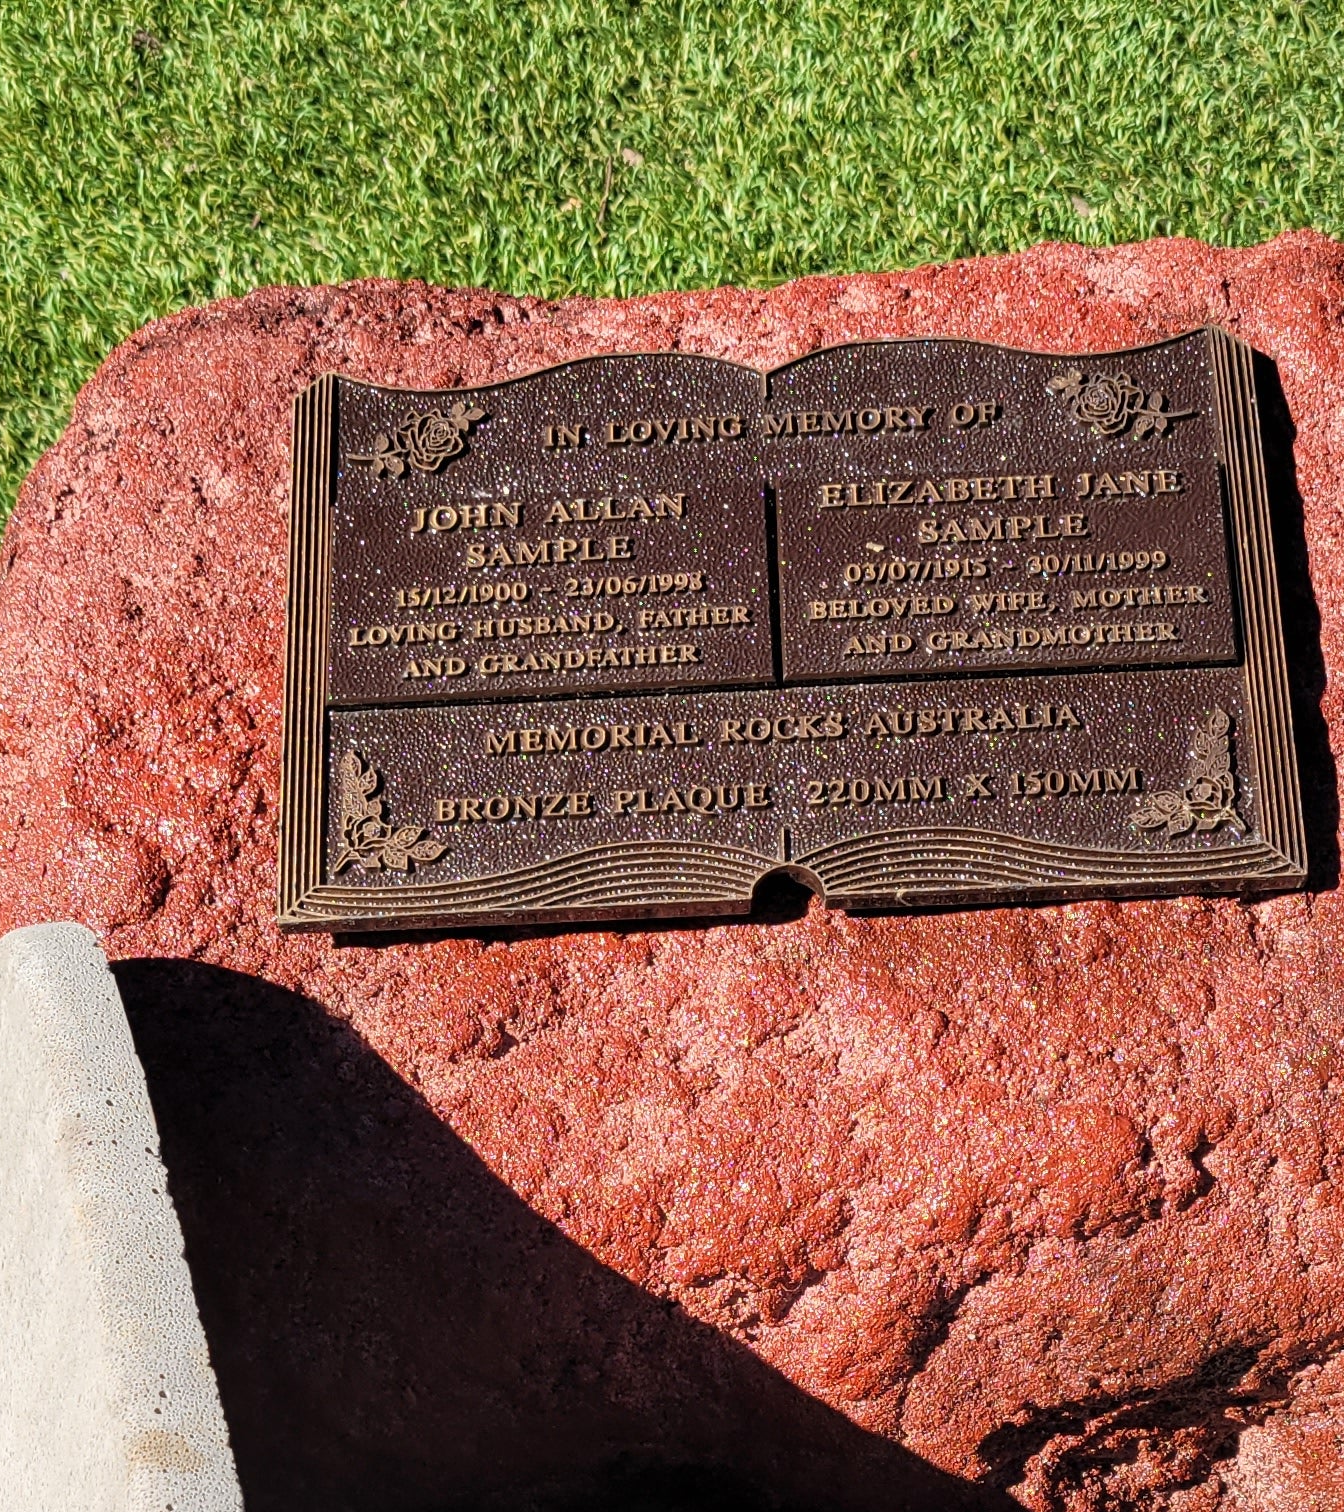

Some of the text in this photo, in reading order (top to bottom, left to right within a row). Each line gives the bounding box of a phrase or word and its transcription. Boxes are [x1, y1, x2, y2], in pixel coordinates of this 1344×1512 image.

[545, 402, 998, 449] IN LOVING MEMORY OF
[819, 470, 1183, 510] ELIZABETH JANE
[411, 493, 687, 532] JOHN ALLAN
[918, 513, 1088, 545] SAMPLE
[465, 536, 632, 569] SAMPLE
[844, 557, 988, 584] 03/07/1915
[1025, 550, 1168, 575] 30/11/1999
[396, 582, 528, 609] 15/12/1900
[563, 571, 704, 598] 23/06/1998
[808, 584, 1206, 621] BELOVED WIFE, MOTHER
[349, 605, 752, 648] LOVING HUSBAND, FATHER
[843, 622, 1179, 656] AND GRANDMOTHER
[402, 645, 699, 679] AND GRANDFATHER
[484, 703, 1082, 756] MEMORIAL ROCKS AUSTRALIA
[436, 767, 1142, 823] BRONZE PLAQUE 220MM X 150MM
